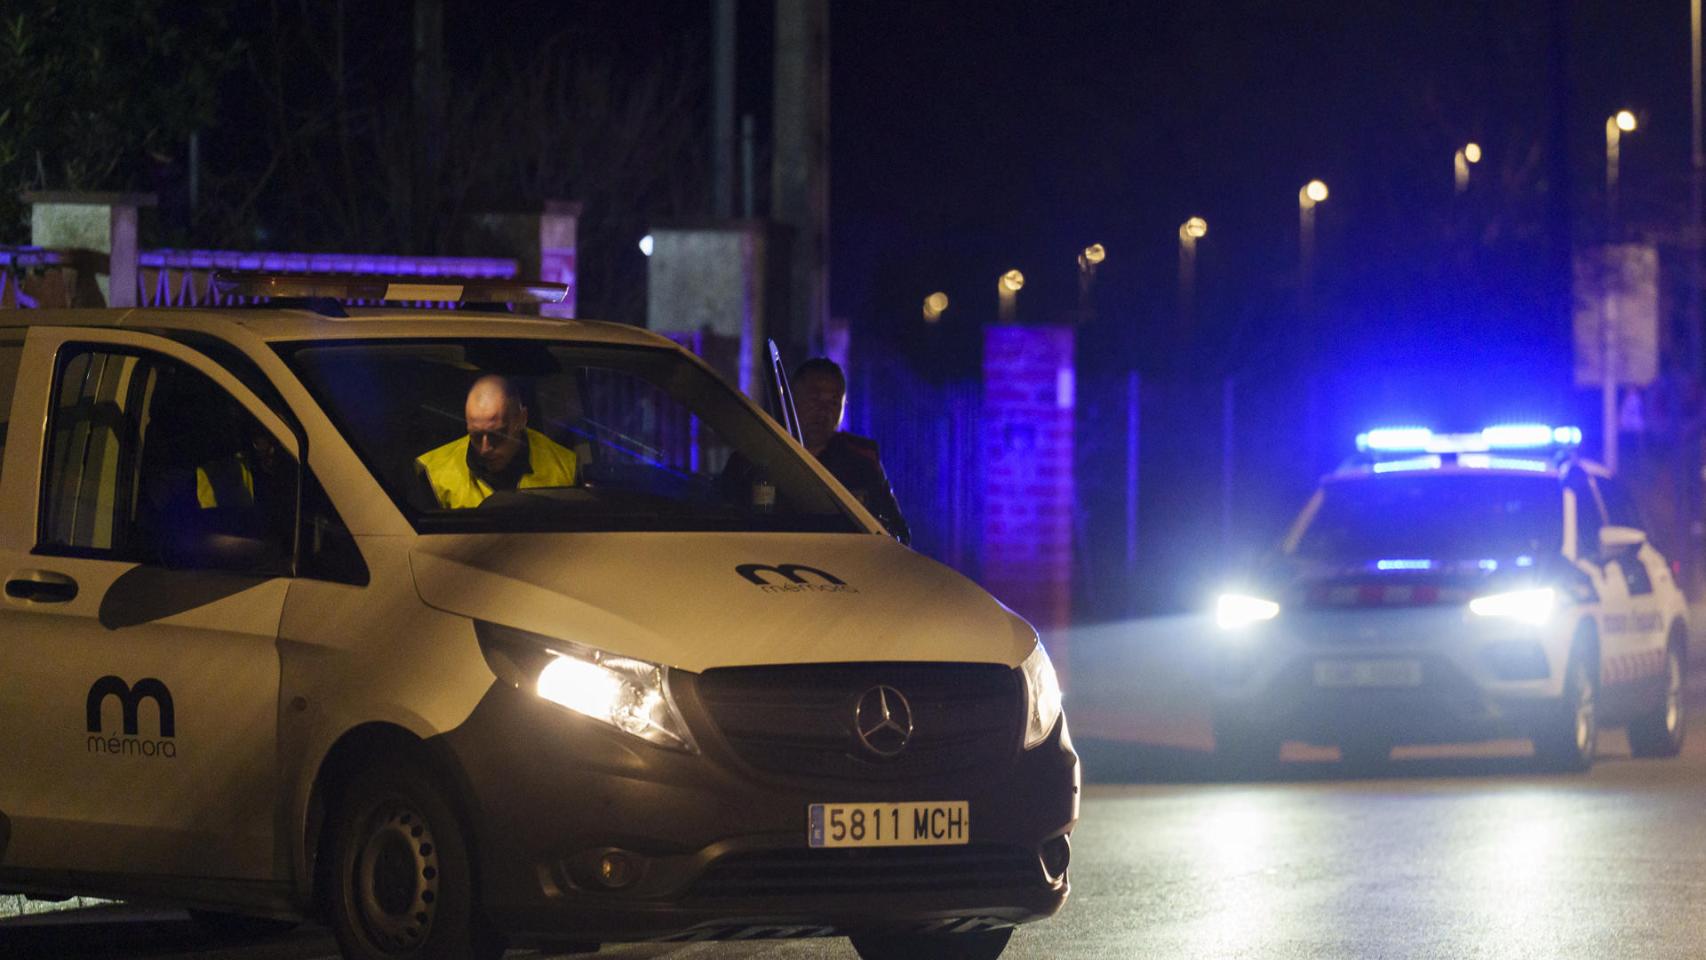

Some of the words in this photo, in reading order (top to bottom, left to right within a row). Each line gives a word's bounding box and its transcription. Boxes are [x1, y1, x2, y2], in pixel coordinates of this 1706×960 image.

[87, 731, 177, 758] mémora
[830, 808, 899, 841] 5811
[913, 807, 962, 840] MCH
